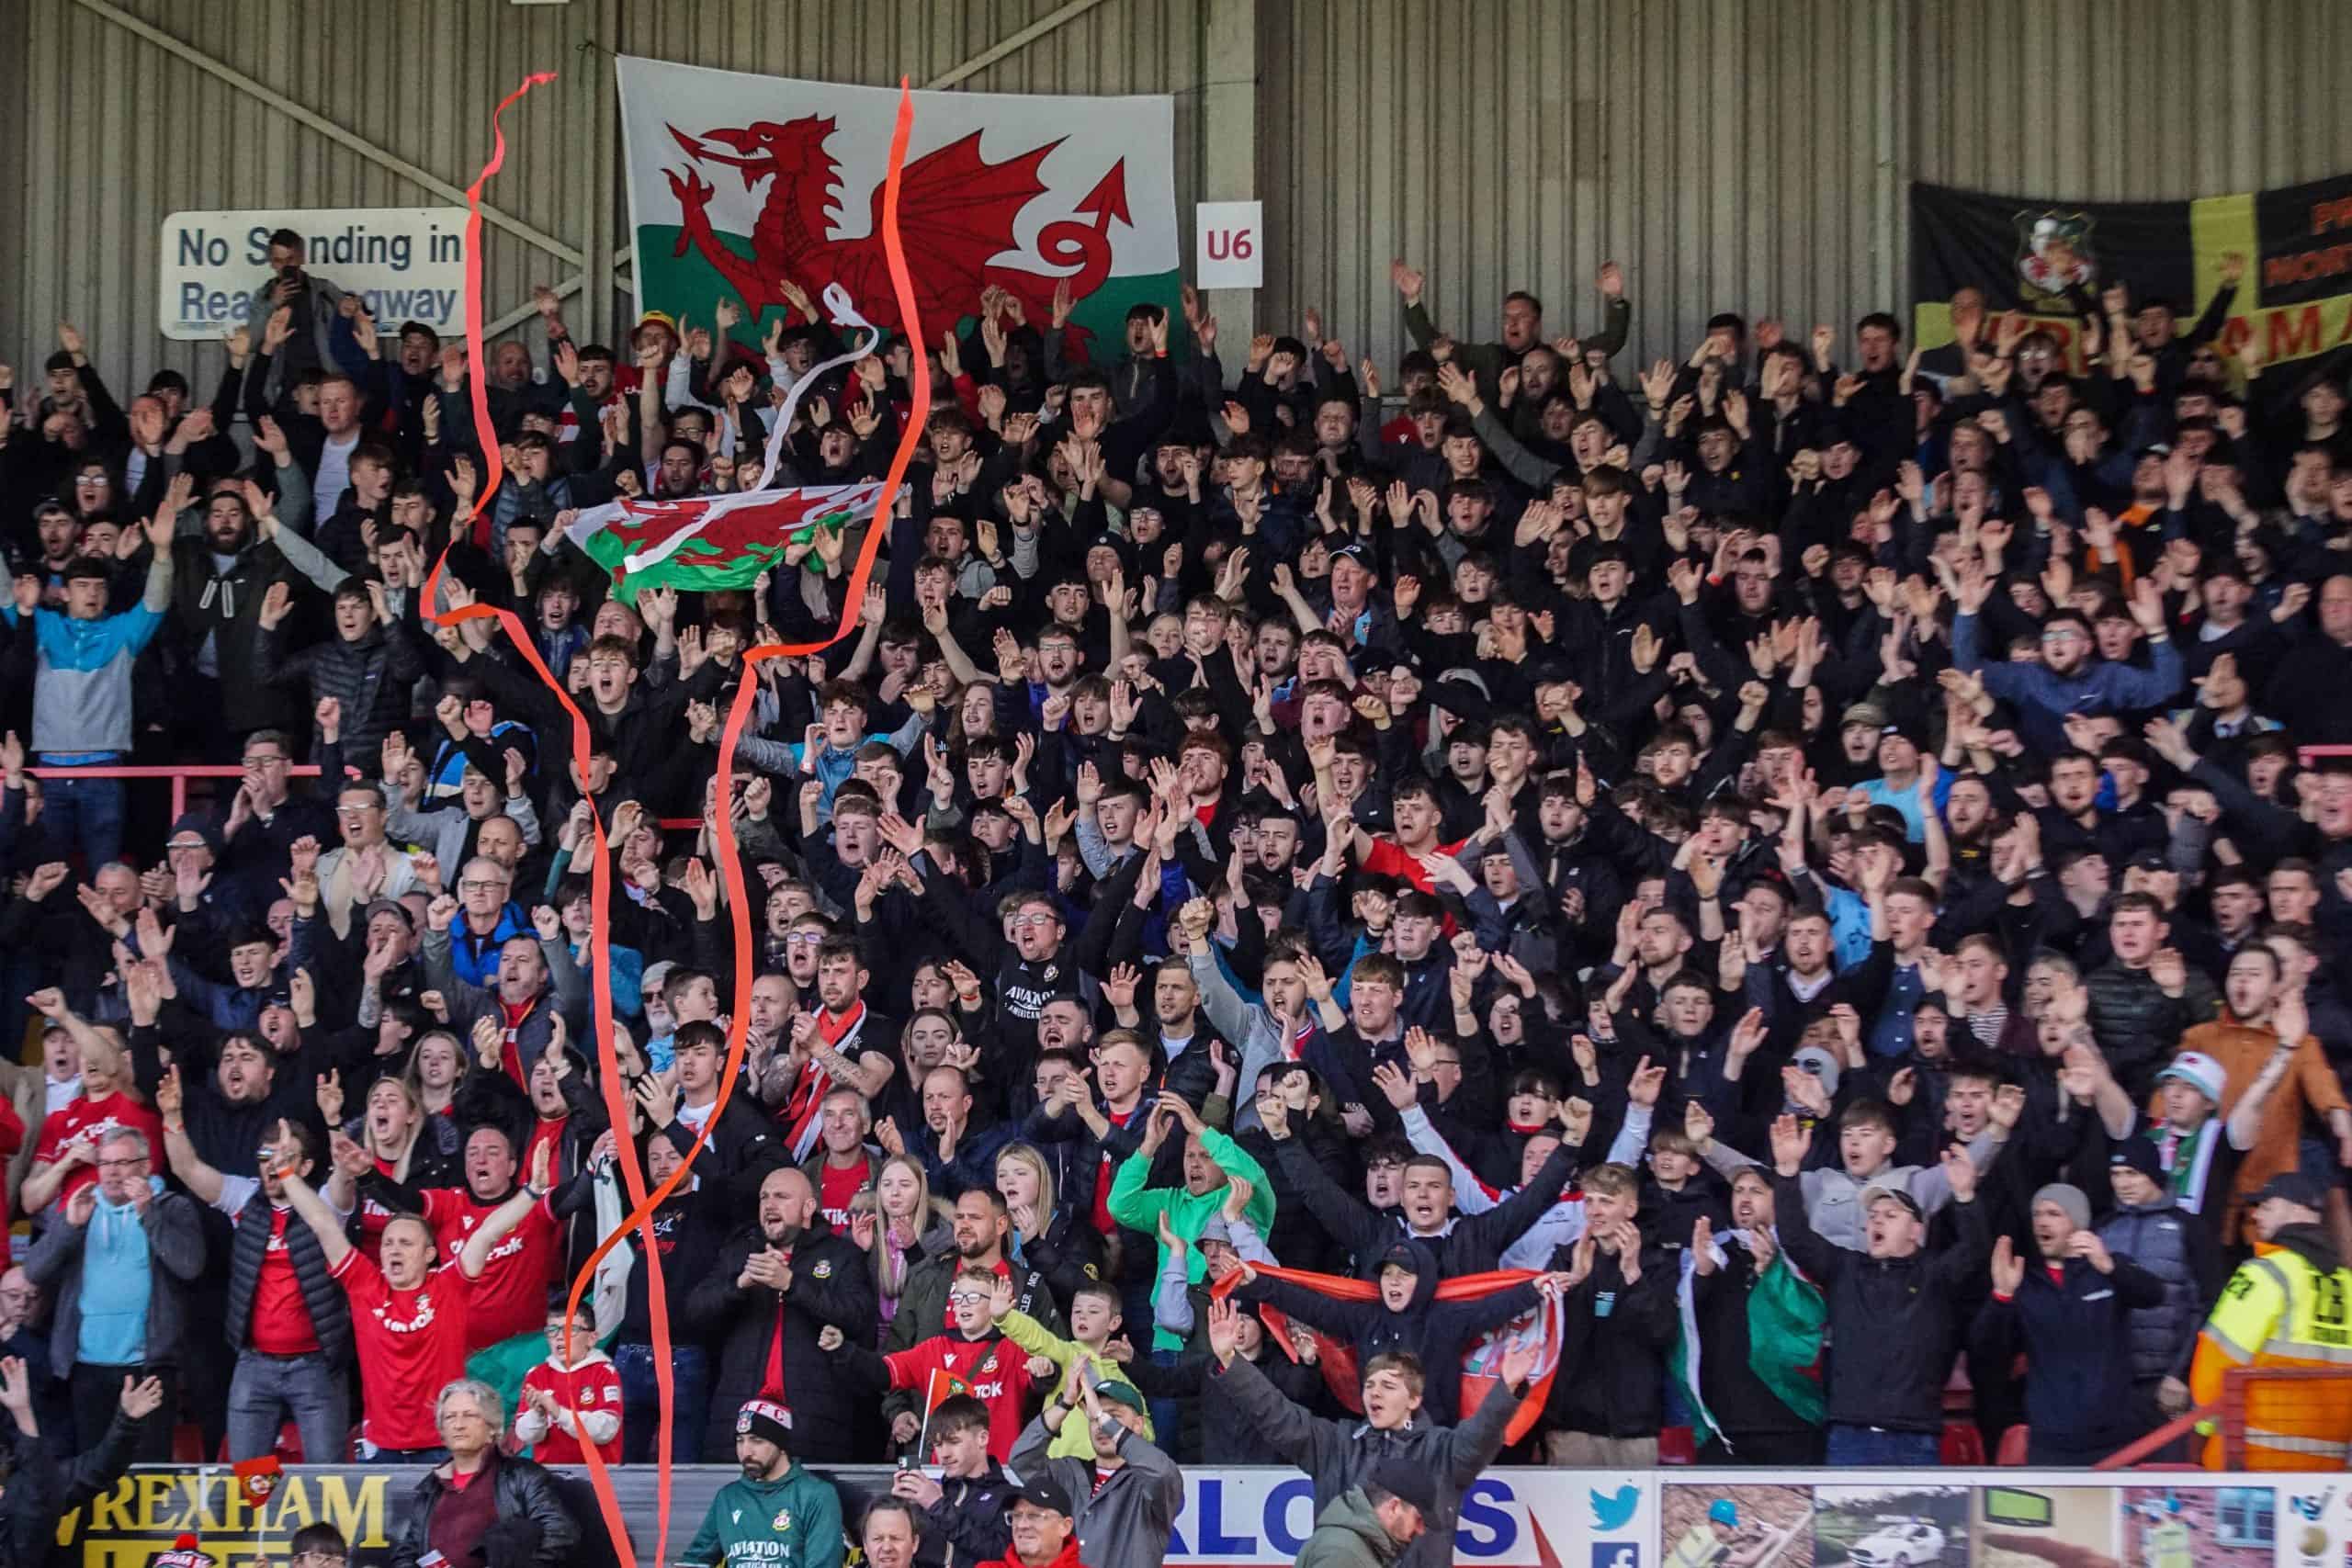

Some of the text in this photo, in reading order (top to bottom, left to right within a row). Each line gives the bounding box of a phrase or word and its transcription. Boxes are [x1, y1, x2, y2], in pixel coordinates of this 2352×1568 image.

[178, 224, 461, 271] No Snding in
[1207, 229, 1252, 260] U6
[180, 281, 457, 325] Rea gway
[56, 1474, 390, 1548] REXHAM
